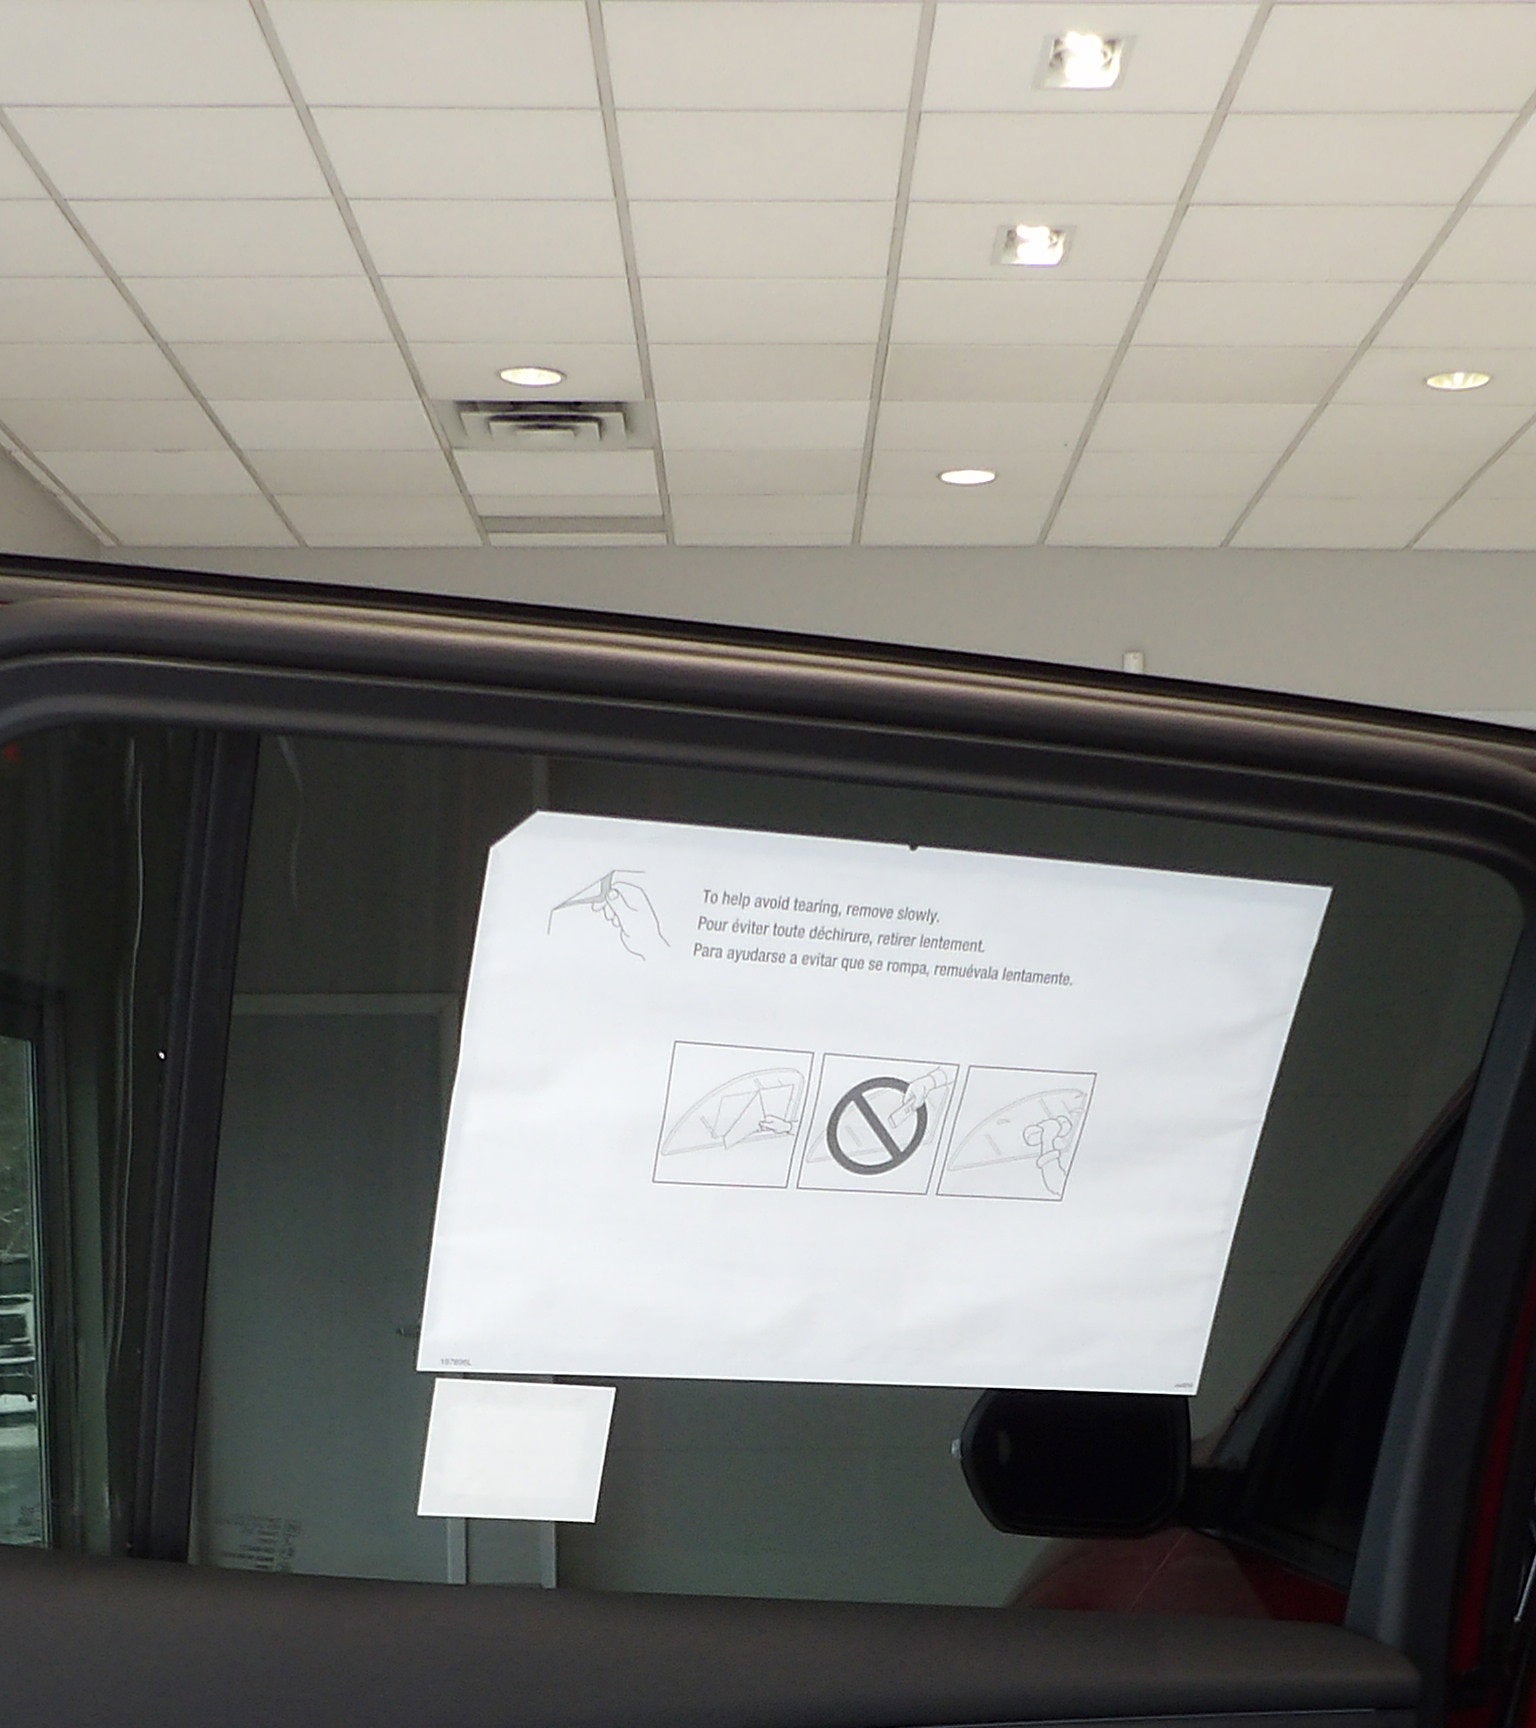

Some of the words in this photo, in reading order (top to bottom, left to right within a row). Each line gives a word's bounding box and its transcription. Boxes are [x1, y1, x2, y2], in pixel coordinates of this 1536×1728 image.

[703, 889, 718, 904] To
[722, 891, 751, 909] help
[754, 895, 790, 910] avoid
[793, 897, 842, 917] tearing,
[846, 904, 894, 919] remove
[897, 907, 940, 925] slowly.
[697, 916, 728, 931] Pour
[731, 918, 769, 935] éviter
[773, 923, 805, 939] toute
[809, 926, 873, 946] déchirure,
[877, 932, 916, 947] retirer
[919, 933, 985, 953] lentement.
[693, 942, 723, 958] Para
[727, 947, 786, 963] ayudarse
[790, 954, 798, 965] a
[802, 952, 838, 967] evitar
[841, 957, 865, 972] que
[868, 960, 883, 971] se
[887, 961, 929, 976] rompa,
[933, 963, 999, 980] remuévala
[1002, 967, 1073, 986] lentamente.
